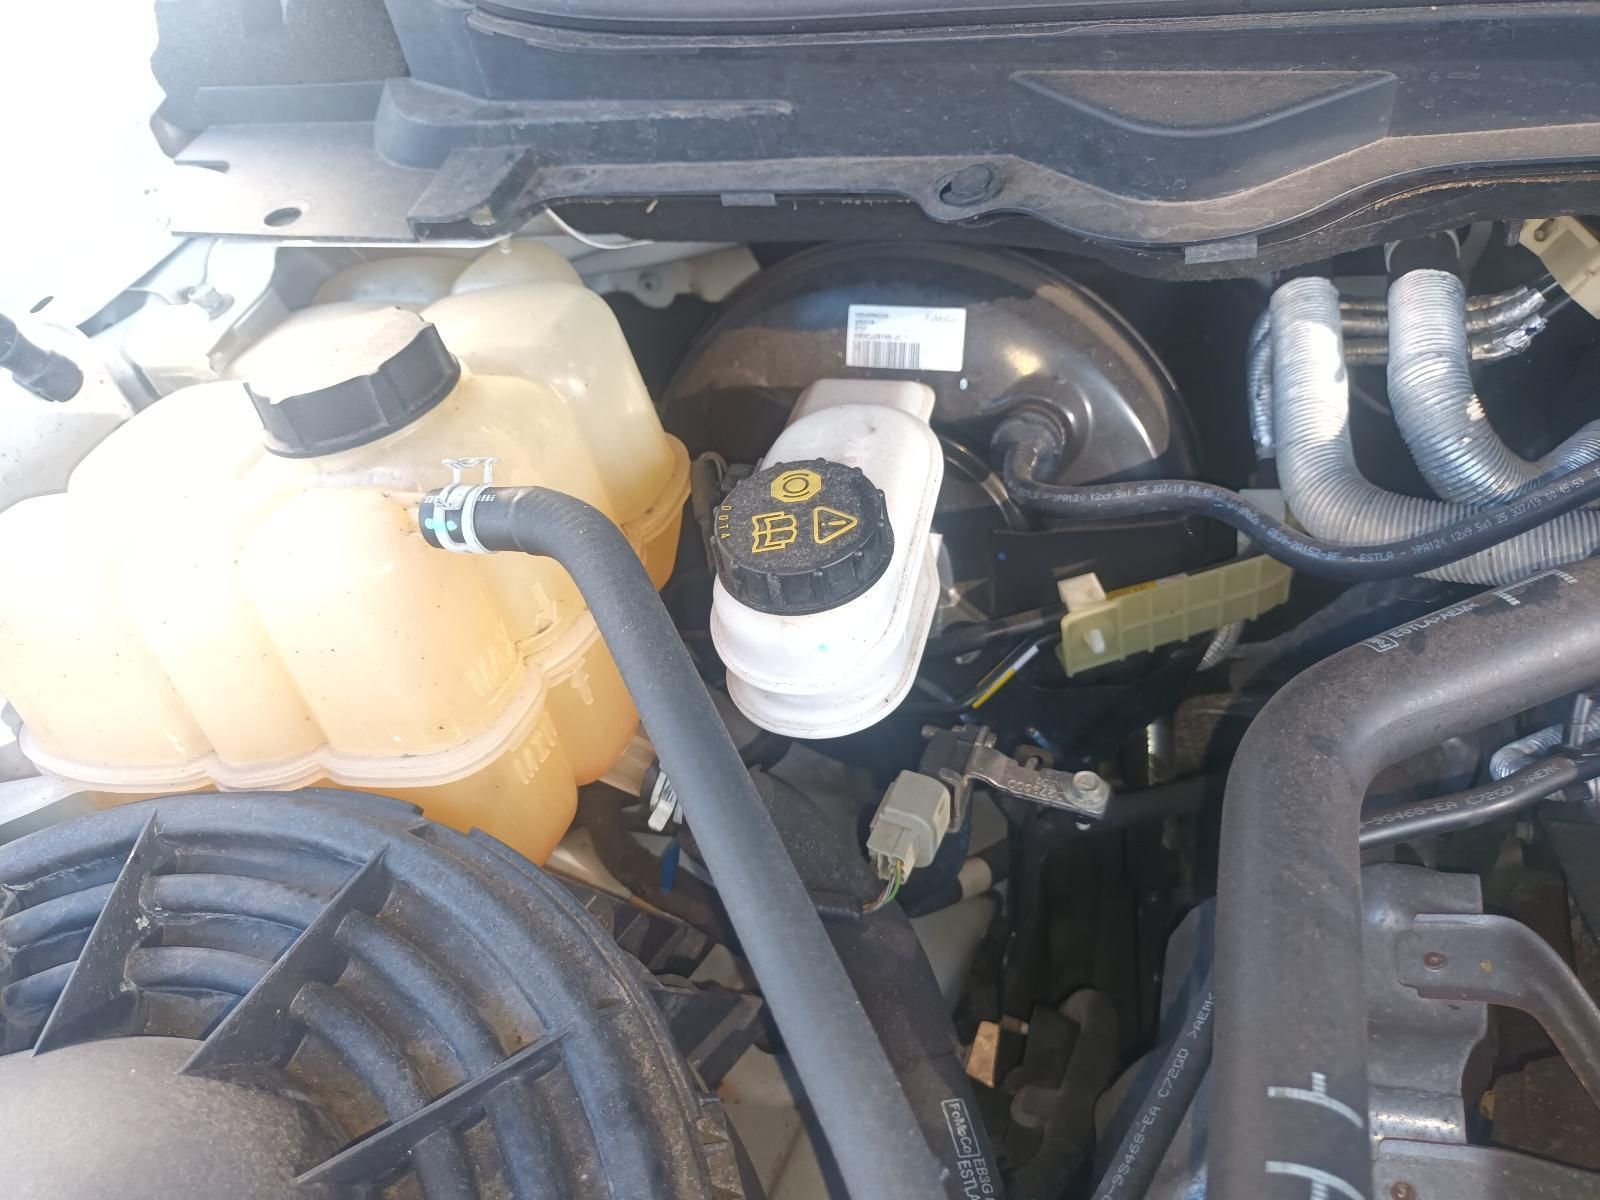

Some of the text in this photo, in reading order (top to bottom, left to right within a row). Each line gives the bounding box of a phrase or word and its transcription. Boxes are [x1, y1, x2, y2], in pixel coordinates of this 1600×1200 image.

[1359, 551, 1394, 563] ESTLA
[1511, 497, 1541, 518] 337/19
[1157, 1048, 1190, 1100] C72GD
[949, 1102, 972, 1154] FoMoCo
